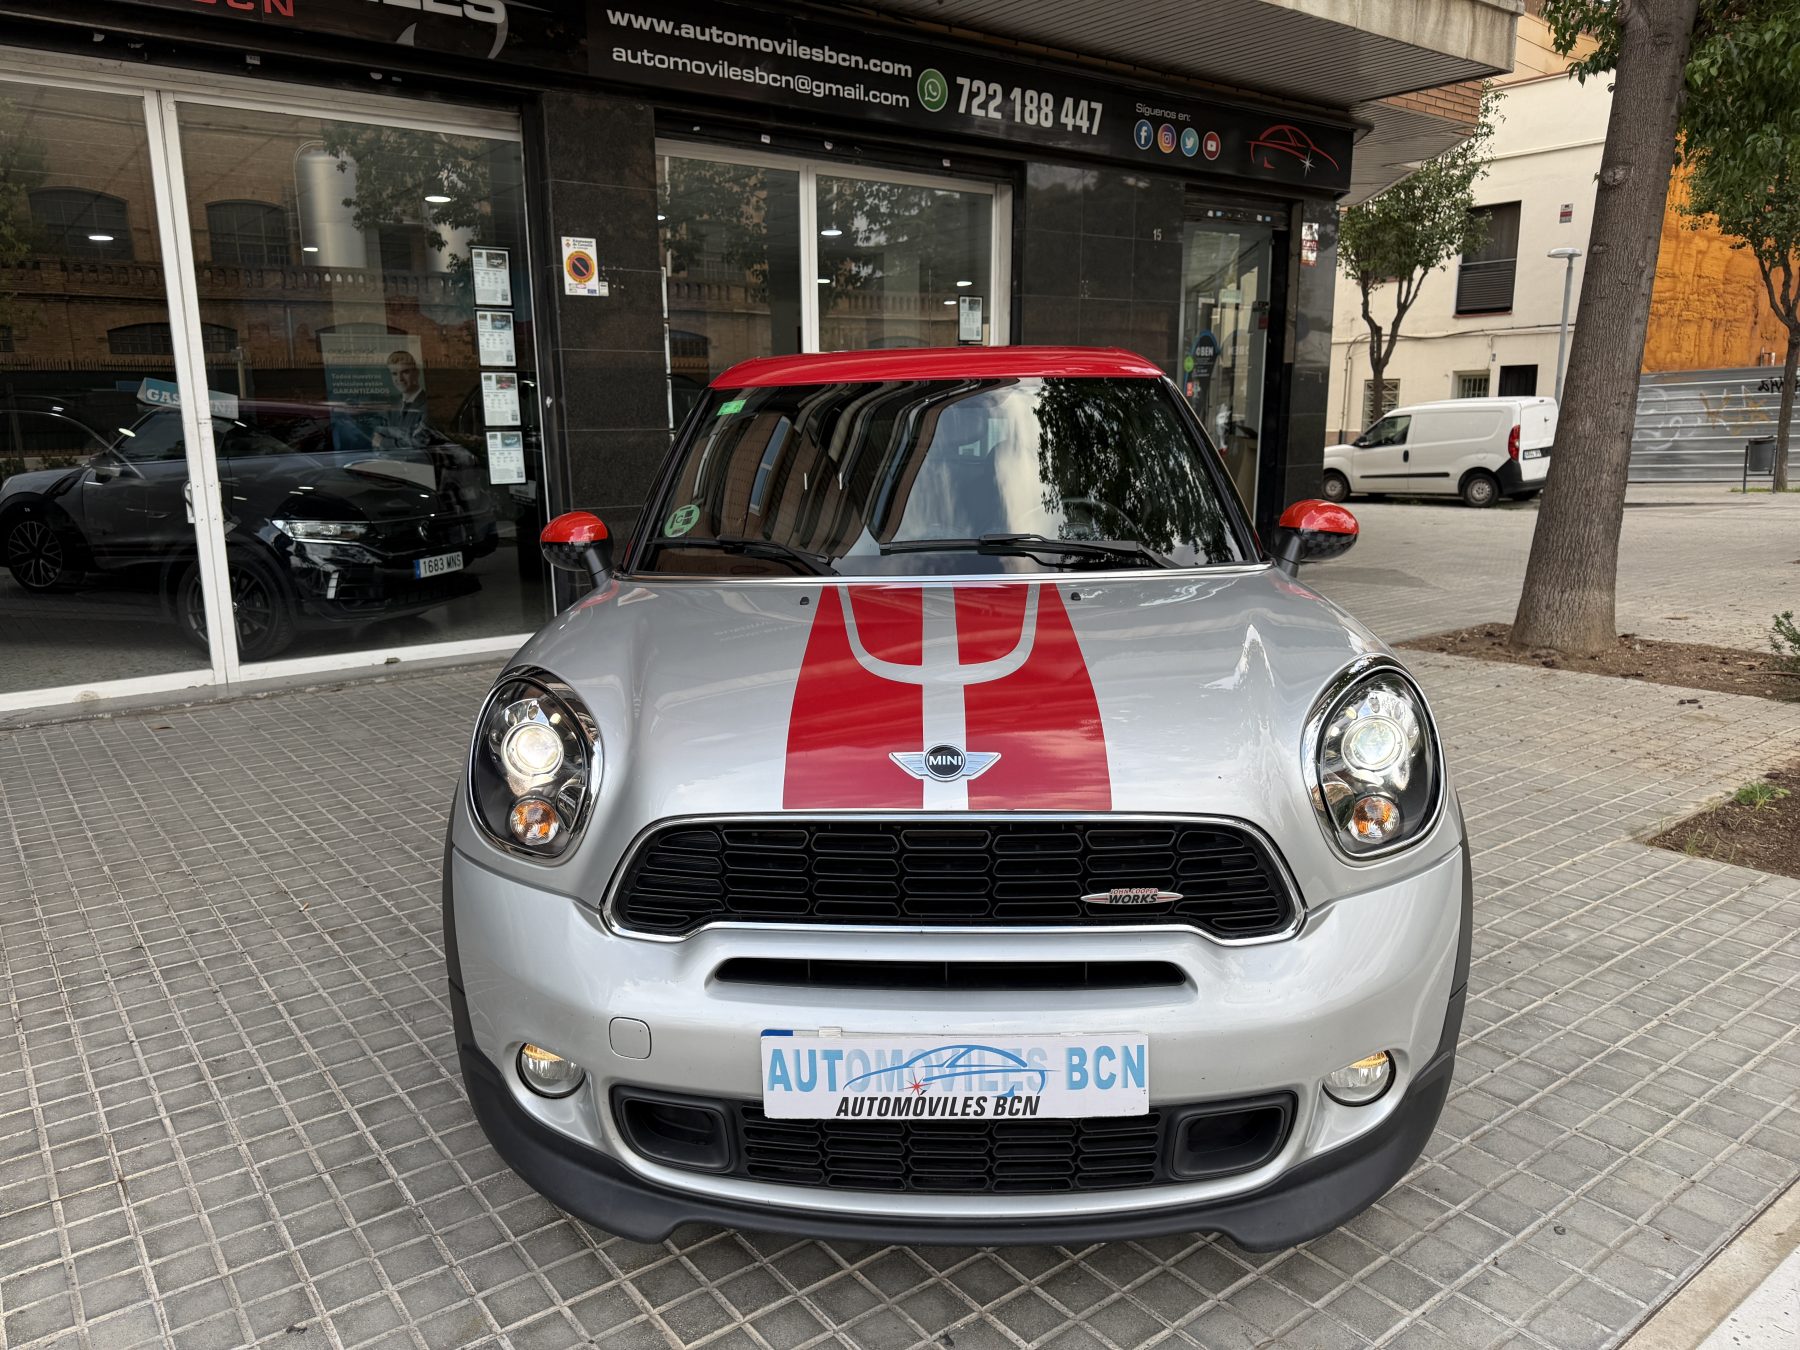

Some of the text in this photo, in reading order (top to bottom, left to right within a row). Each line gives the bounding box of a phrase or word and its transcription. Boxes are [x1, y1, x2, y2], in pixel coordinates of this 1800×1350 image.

[606, 9, 913, 78] www.automovilesbcn.com
[611, 46, 910, 108] automovilesbcn@gmail.com
[956, 76, 1103, 136] 722 188 447
[1153, 228, 1162, 241] 15
[423, 554, 462, 574] 1683 MNS
[928, 755, 962, 766] MINI
[1108, 894, 1158, 904] WORKS
[1065, 1044, 1145, 1090] BCN
[836, 1089, 1041, 1117] AUTOMÓVILES BCN
